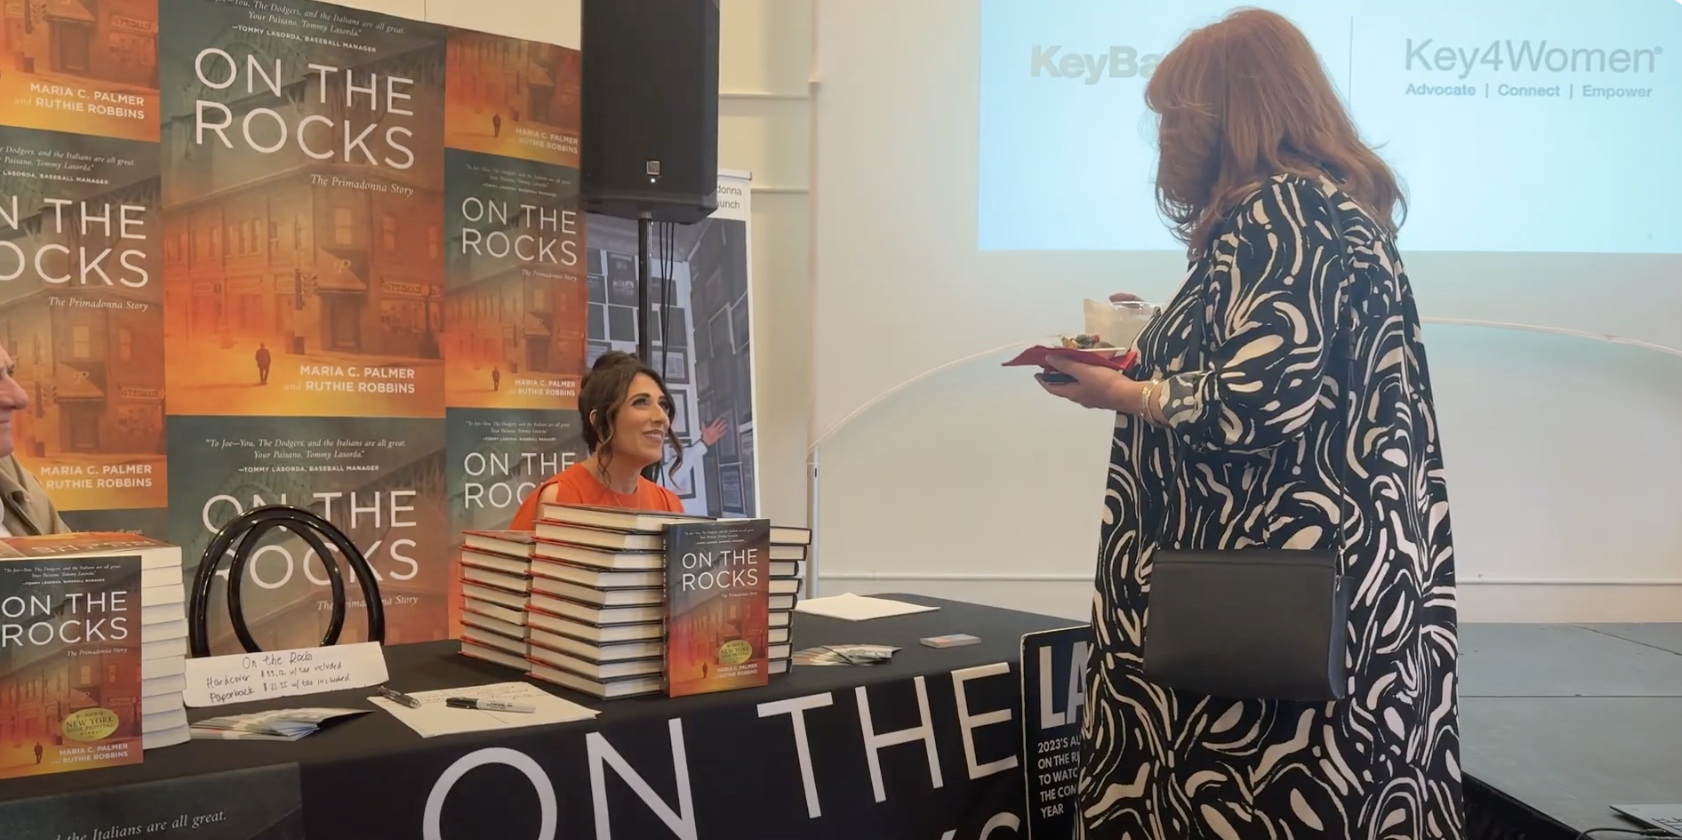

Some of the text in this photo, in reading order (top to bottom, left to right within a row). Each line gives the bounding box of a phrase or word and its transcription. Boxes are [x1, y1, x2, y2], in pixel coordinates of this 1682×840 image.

[248, 11, 328, 33] Your Paisano, Tommy
[253, 0, 268, 10] The
[270, 3, 301, 15] Dodgers,
[304, 10, 318, 18] and
[320, 12, 333, 20] the
[333, 14, 360, 26] Italians
[375, 22, 385, 30] all
[266, 30, 303, 41] LASORDA,
[304, 36, 341, 47] BASEBALL
[342, 42, 377, 53] MANAGER
[1030, 45, 1163, 85] KeyBa
[195, 47, 414, 116] ON THE
[30, 83, 144, 106] MARIA C. PALMER
[1405, 83, 1653, 100] Advocate Connect Empower
[36, 97, 84, 112] RUTHIE
[88, 104, 145, 119] ROBBINS
[195, 100, 415, 169] ROCKS
[550, 134, 578, 145] PALMER
[66, 152, 92, 161] Italians
[546, 142, 578, 154] ROBBINS
[36, 159, 62, 170] Tommy
[39, 173, 74, 182] BASEBALL
[76, 177, 109, 185] MANAGER
[311, 173, 414, 197] The Primadonna Story
[717, 184, 742, 196] donna
[44, 198, 146, 240] THE
[462, 197, 577, 235] ON THE
[462, 227, 577, 266] ROCKS
[0, 240, 149, 288] OCKS
[49, 296, 148, 312] The Primadonna Story
[300, 365, 415, 379] MARIA C. PALMER
[305, 381, 354, 392] RUTHIE
[359, 382, 415, 394] ROBBINS
[518, 388, 544, 396] RUTHIE
[545, 388, 576, 397] ROBBINS
[548, 380, 576, 388] PALMER
[258, 438, 272, 447] The
[308, 439, 321, 447] and
[323, 439, 334, 447] the
[336, 439, 362, 447] Italians
[377, 439, 387, 447] all
[254, 450, 332, 461] Your Paisano, Tommy
[464, 452, 576, 476] ON THE
[40, 464, 152, 476] MARIA C. PALMER
[46, 478, 153, 489] RUTHIE ROBBINS
[313, 490, 417, 529] THE
[682, 548, 758, 569] ON THE
[682, 568, 758, 592] ROCKS
[1, 590, 128, 618] ON THE
[395, 594, 419, 606] Story
[1, 617, 128, 648] ROCKS
[242, 656, 257, 669] On
[263, 654, 283, 666] the
[206, 674, 250, 688] Hardcover
[314, 661, 342, 671] included
[210, 686, 255, 703] Paperback
[317, 673, 350, 685] included
[66, 717, 114, 728] NEW YORK
[59, 748, 86, 756] MARIA
[97, 743, 128, 752] PALMER
[422, 661, 1019, 840] ON THE
[1037, 737, 1068, 754] 2023'S
[63, 754, 91, 764] RUTHIE
[94, 751, 128, 760] ROBBINS
[1037, 753, 1070, 769] ON THE
[1038, 767, 1078, 786] TO WATC
[1040, 788, 1056, 802] THE
[1040, 803, 1064, 819] YEAR
[93, 825, 142, 840] Italians
[146, 821, 167, 832] are
[171, 814, 188, 828] all
[191, 810, 227, 828] great.
